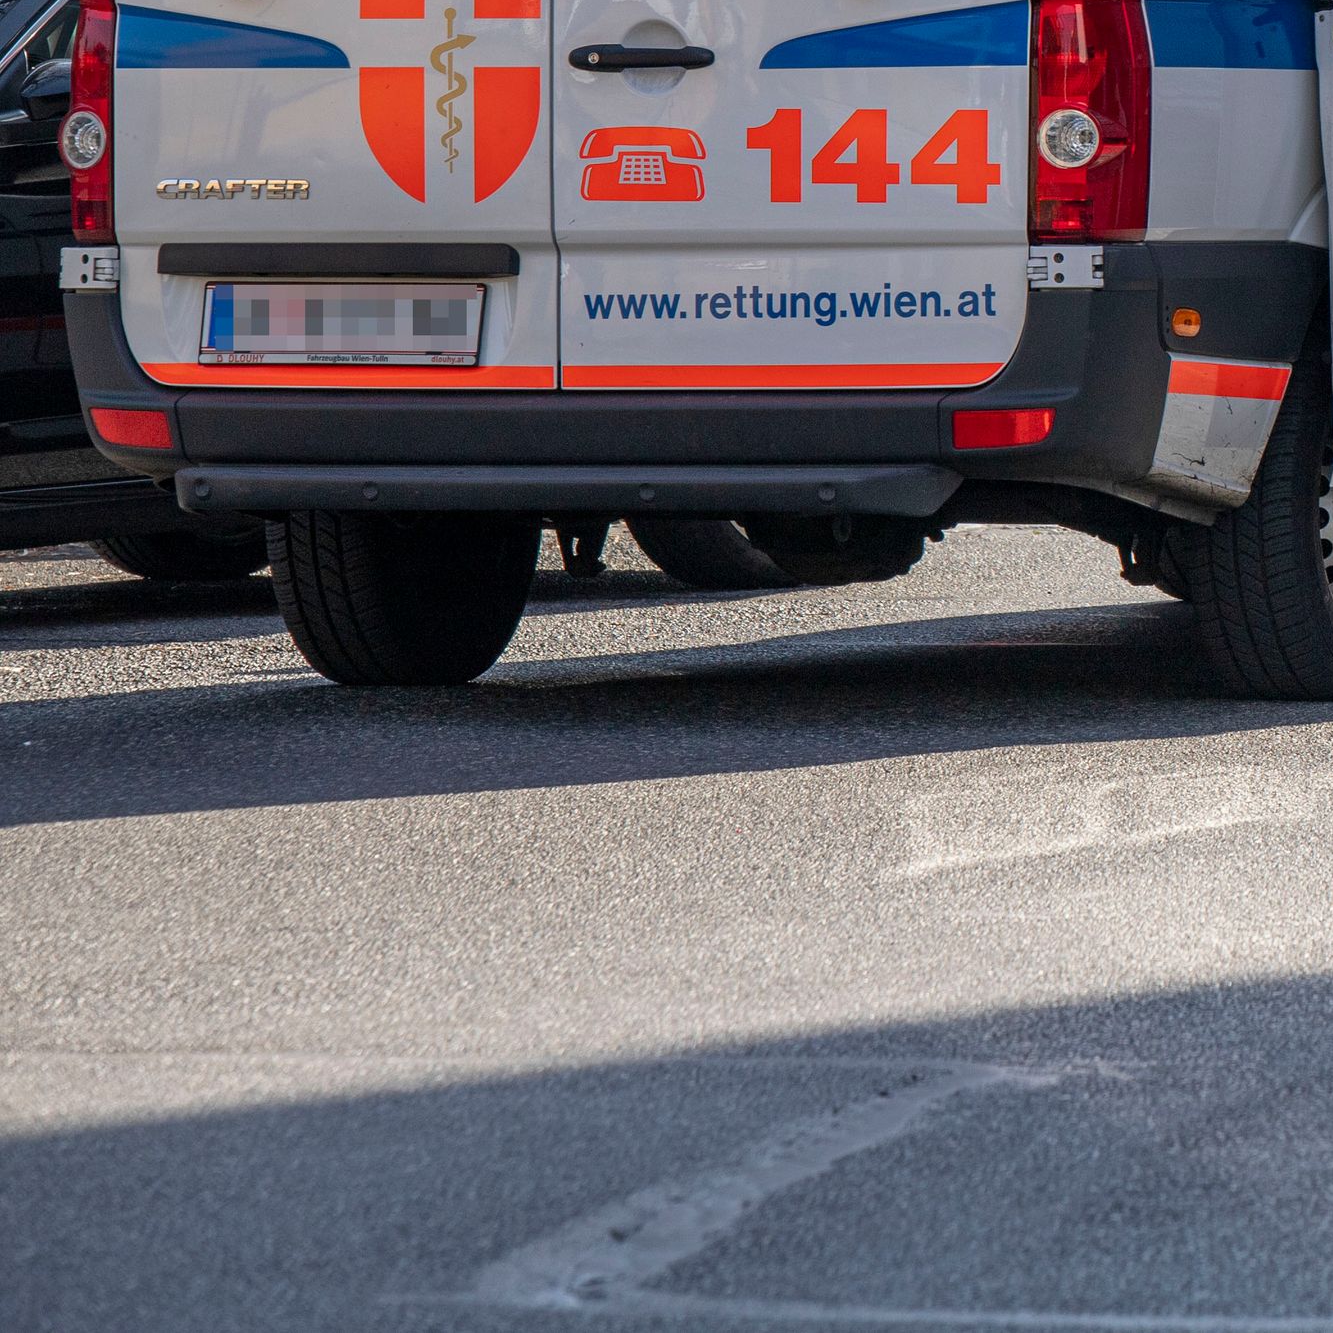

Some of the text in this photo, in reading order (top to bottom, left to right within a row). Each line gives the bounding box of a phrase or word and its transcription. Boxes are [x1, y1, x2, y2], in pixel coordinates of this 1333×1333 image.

[746, 108, 1001, 204] 144
[156, 178, 311, 200] CRAFTER
[584, 283, 997, 326] www.rettung.wien.at
[228, 353, 265, 364] DLOUHY
[306, 354, 350, 363] Fahrzeugbau
[431, 356, 465, 365] dlouhy.at
